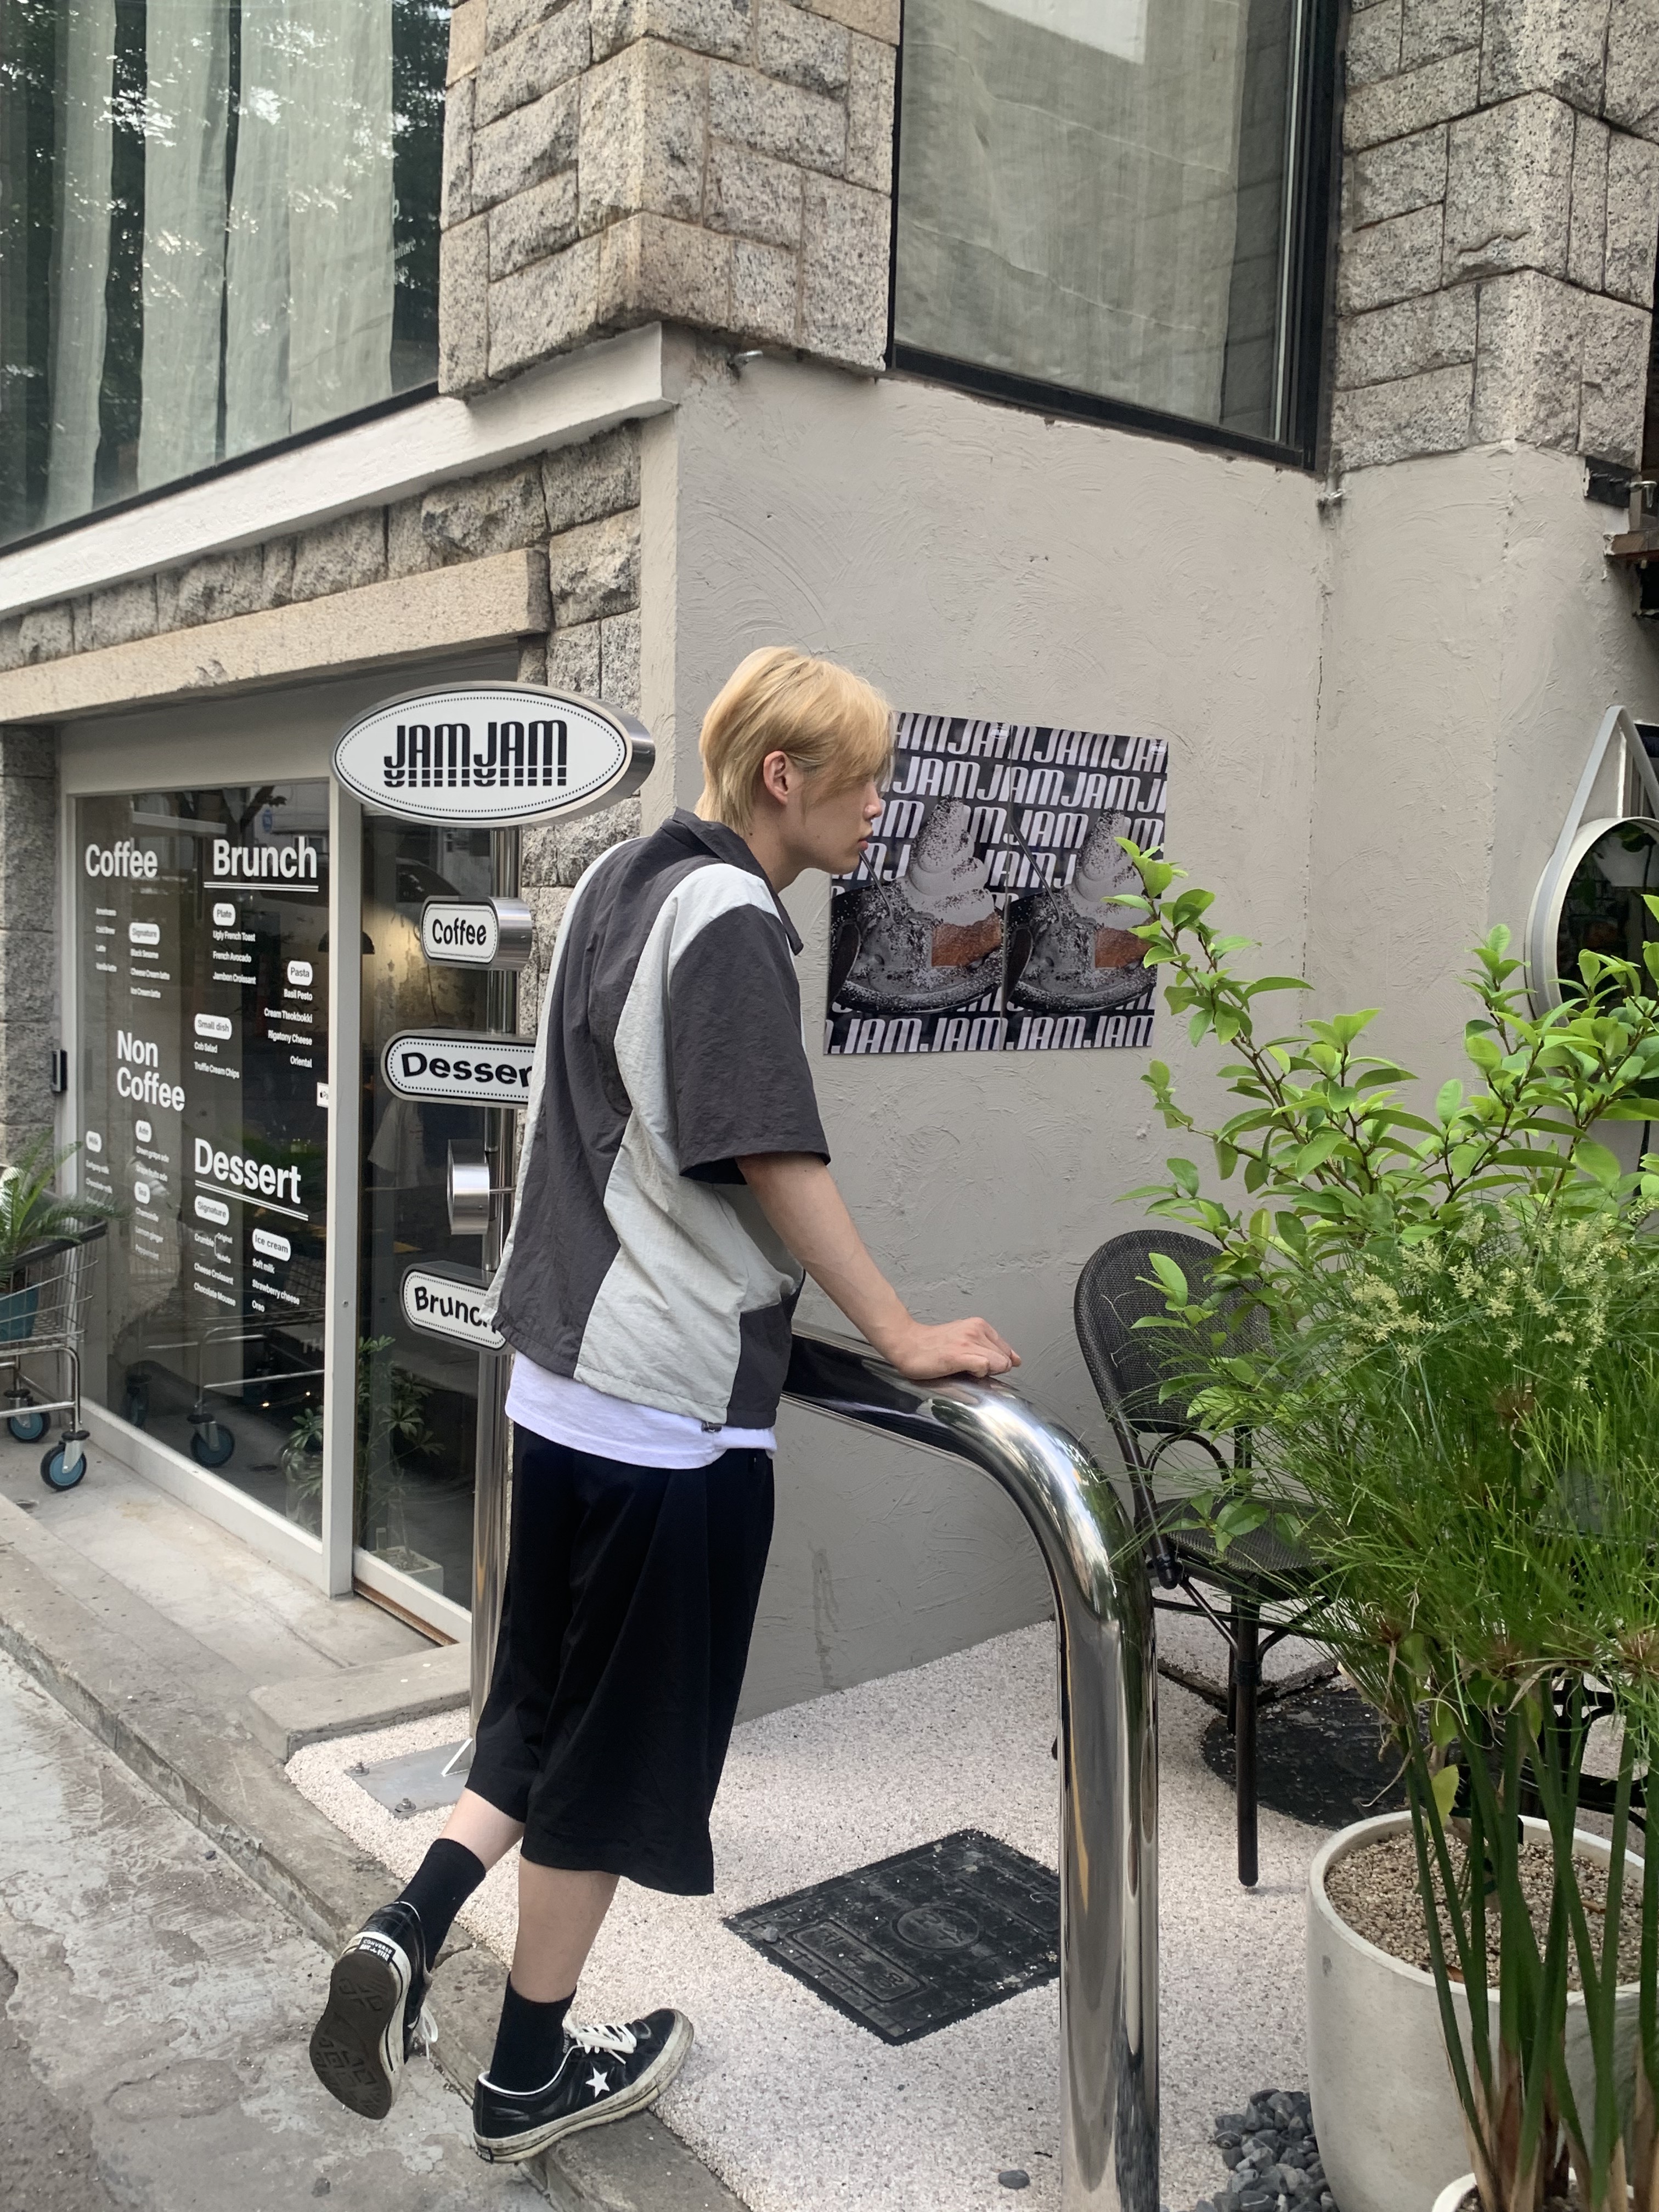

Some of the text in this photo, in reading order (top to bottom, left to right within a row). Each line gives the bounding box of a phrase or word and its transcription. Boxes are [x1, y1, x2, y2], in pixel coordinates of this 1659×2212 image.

[384, 720, 567, 787] JAMJAM
[85, 842, 158, 877] Coffee
[213, 836, 318, 878] Brunch
[217, 909, 232, 918] Plate
[213, 930, 256, 942] Ugly French Toast
[432, 918, 487, 945] Coffee
[213, 951, 252, 963] French Avocado
[213, 972, 256, 985] Jambon Croissant
[290, 967, 309, 978] Pasta
[284, 989, 313, 1001] Basil Pesto
[264, 1008, 281, 1019] Cream
[198, 1019, 229, 1032] Small dish
[268, 1030, 313, 1046] Rigatony Cheese
[117, 1030, 159, 1068] Non
[204, 1043, 218, 1053] Salad
[194, 1062, 240, 1079] Truffle Cream Chips
[290, 1056, 312, 1068] Oriental
[117, 1067, 185, 1111] Coffee
[195, 1138, 302, 1204] Dessert
[198, 1201, 227, 1218] Signature
[255, 1234, 289, 1254] Ice cream
[194, 1262, 234, 1285] Cheese Croissant
[252, 1257, 275, 1274] Soft milk
[194, 1282, 236, 1307] Chocolate Mousse
[252, 1279, 300, 1305] Strawberry cheese
[252, 1300, 265, 1312] Oreo
[414, 1285, 498, 1334] Brunc
[363, 1939, 393, 1954] CONVERSE
